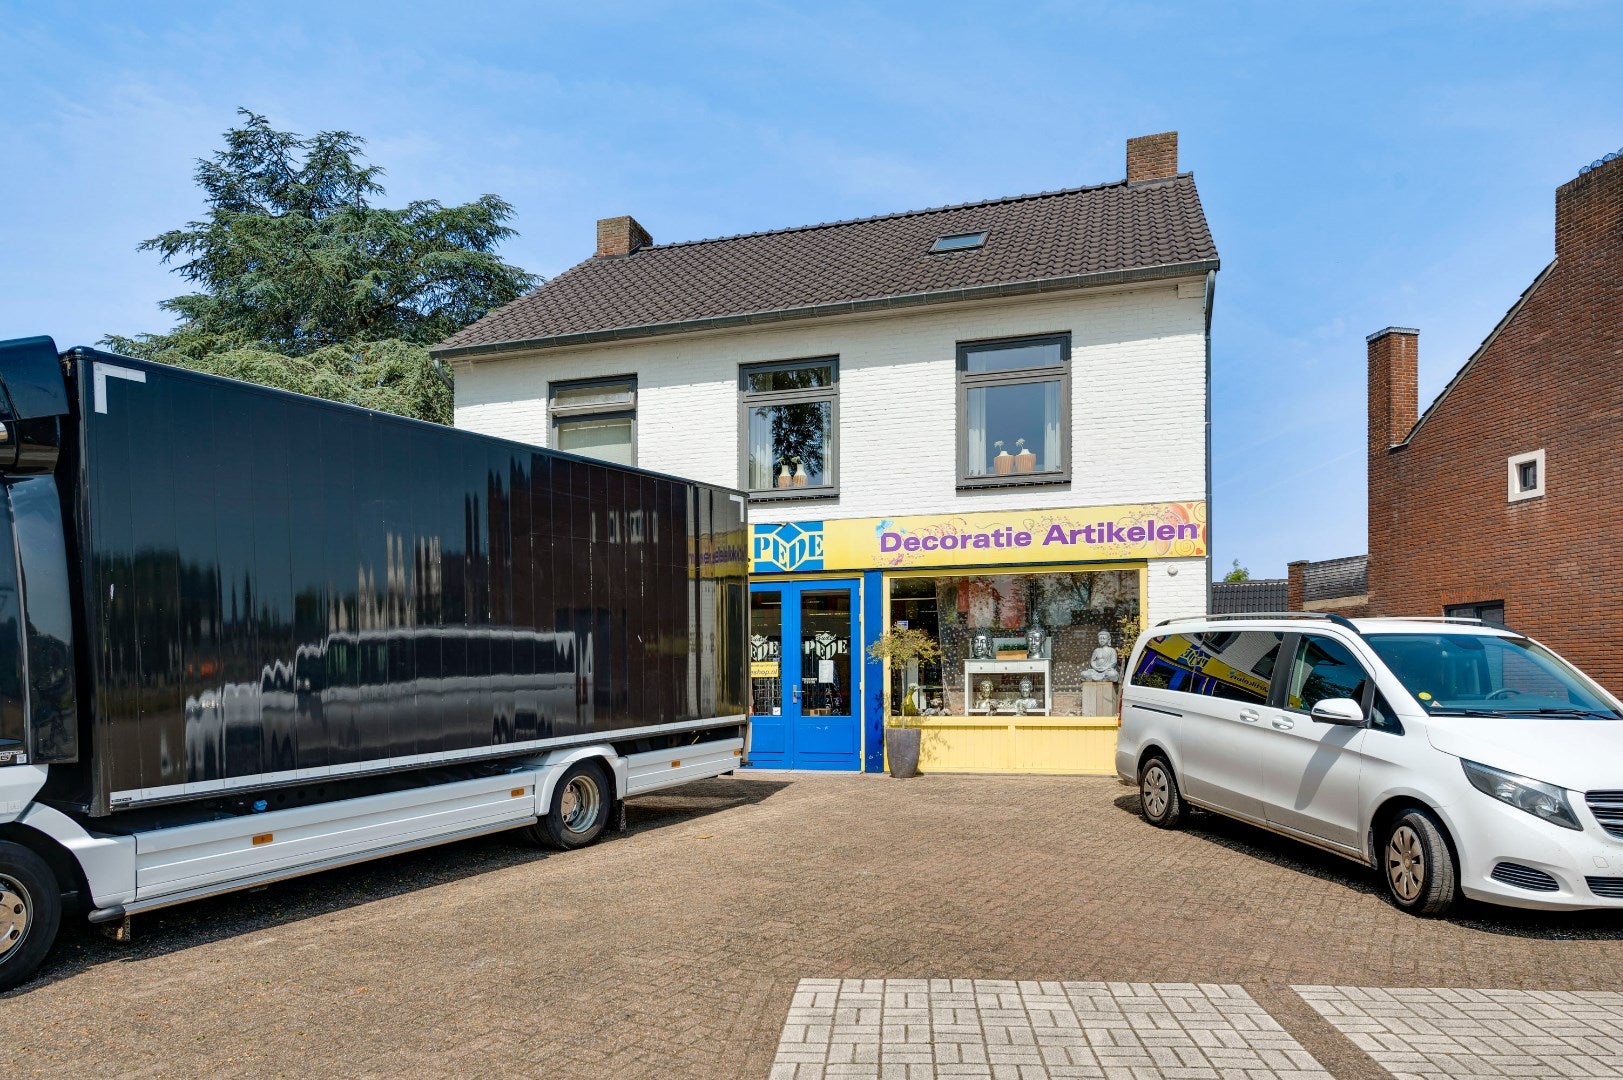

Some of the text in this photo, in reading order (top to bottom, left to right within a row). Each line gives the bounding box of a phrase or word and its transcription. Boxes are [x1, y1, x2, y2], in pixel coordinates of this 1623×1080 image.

[881, 520, 1198, 552] Decoratie Artikelen
[754, 532, 824, 570] PEDE
[751, 641, 779, 661] EDE
[804, 640, 848, 661] PEDE
